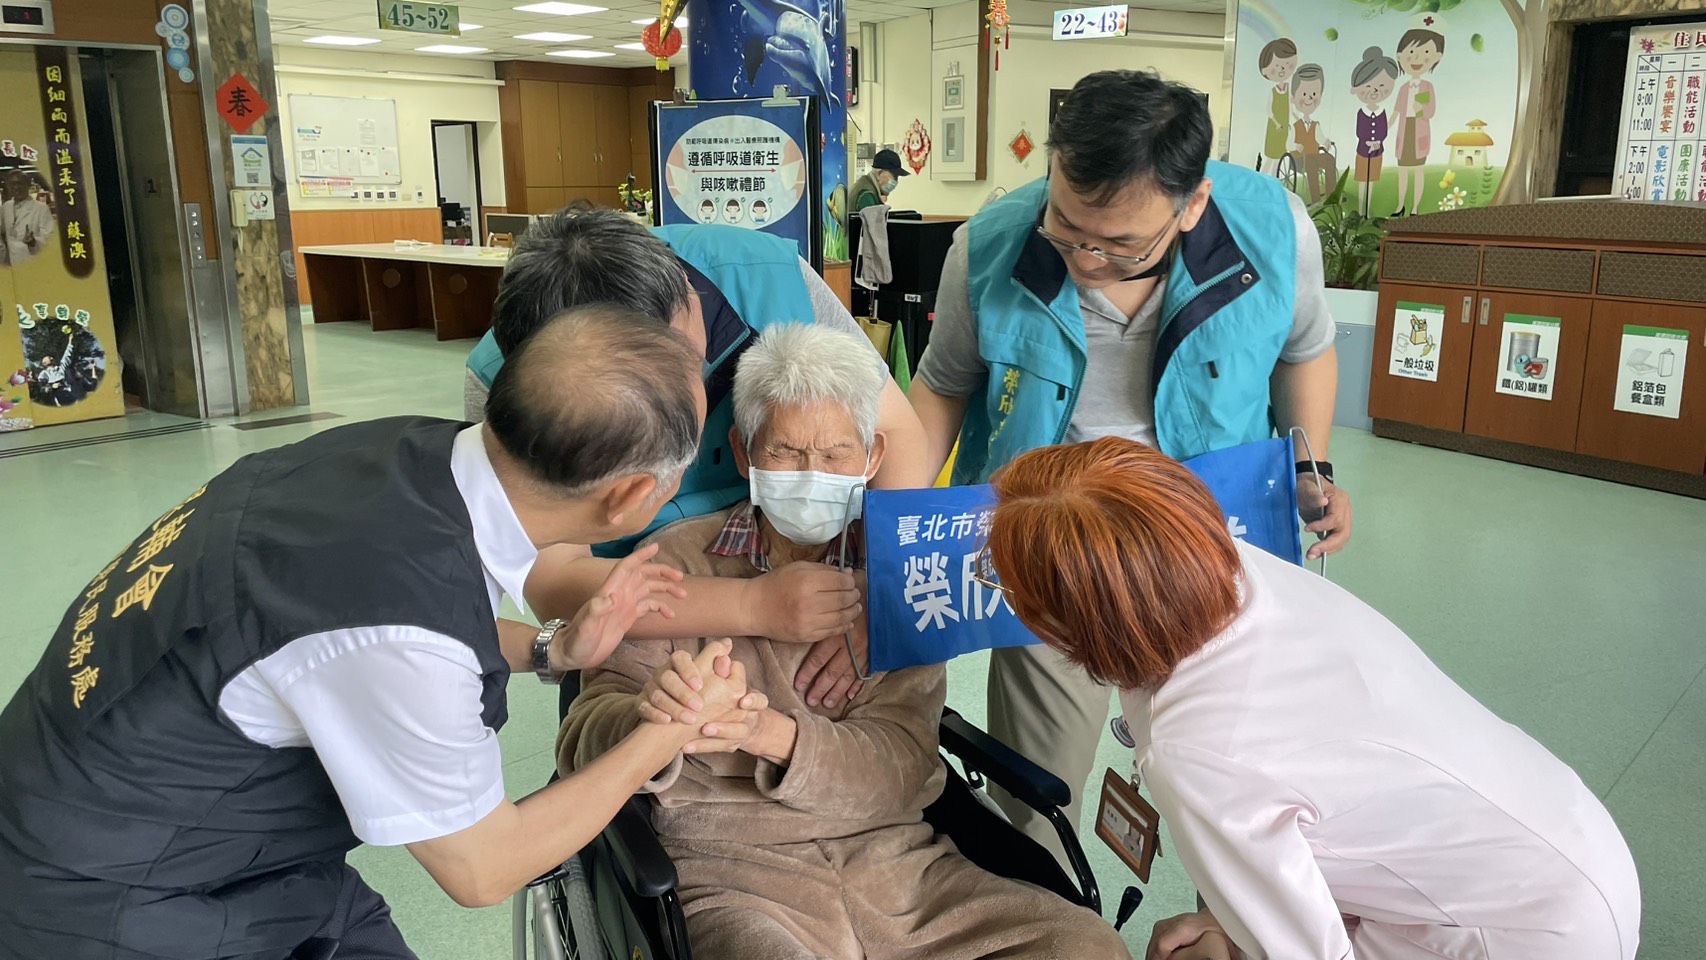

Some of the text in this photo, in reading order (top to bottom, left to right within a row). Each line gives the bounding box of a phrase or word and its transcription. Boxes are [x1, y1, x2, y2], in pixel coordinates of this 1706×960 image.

[387, 4, 449, 30] 45~52
[1061, 11, 1118, 35] 22~43
[1638, 78, 1656, 90] 上午
[227, 87, 253, 117] 春
[1637, 93, 1653, 105] 9:00
[1683, 75, 1701, 134] 職能活動
[1633, 118, 1652, 131] 11:00
[688, 150, 779, 167] 遵循呼吸道衛生
[1631, 146, 1647, 157] 下午
[1628, 162, 1644, 174] 2:00
[1674, 144, 1692, 201] 團康活動
[701, 176, 766, 192] 與咳嗽禮節
[1395, 357, 1435, 372] 一般垃圾
[1632, 380, 1667, 395] 鋁箔包
[1631, 393, 1666, 407] 餐盒類
